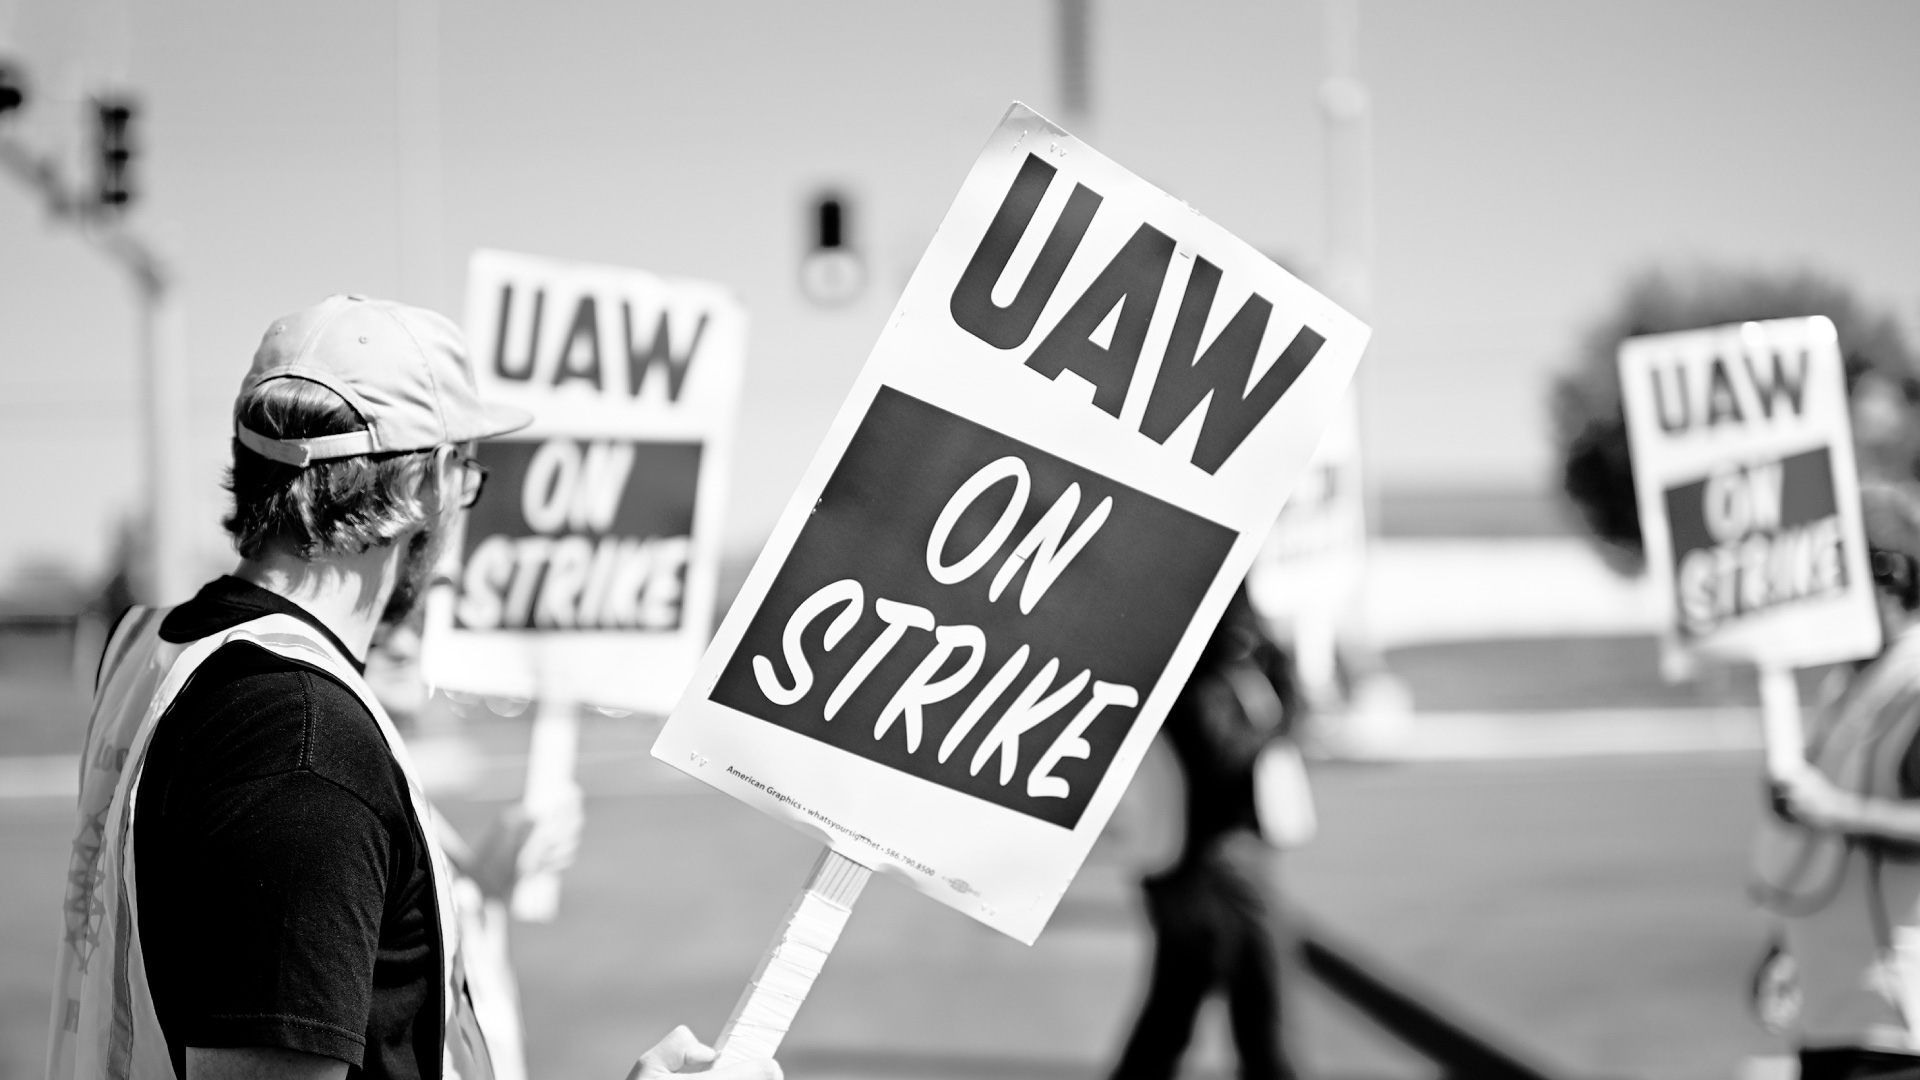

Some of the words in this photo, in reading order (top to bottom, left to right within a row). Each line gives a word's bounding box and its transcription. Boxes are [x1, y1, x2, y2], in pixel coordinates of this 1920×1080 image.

[493, 283, 711, 405] UAW
[949, 152, 1327, 476] UAW
[1650, 349, 1808, 434] UAW
[521, 438, 637, 534] ON
[926, 455, 1114, 615] ON
[456, 533, 696, 632] STRIKE
[751, 578, 1139, 800] STRIKE
[726, 765, 766, 791] American
[766, 786, 802, 811] Graphics
[884, 848, 936, 877] 586.790.8500
